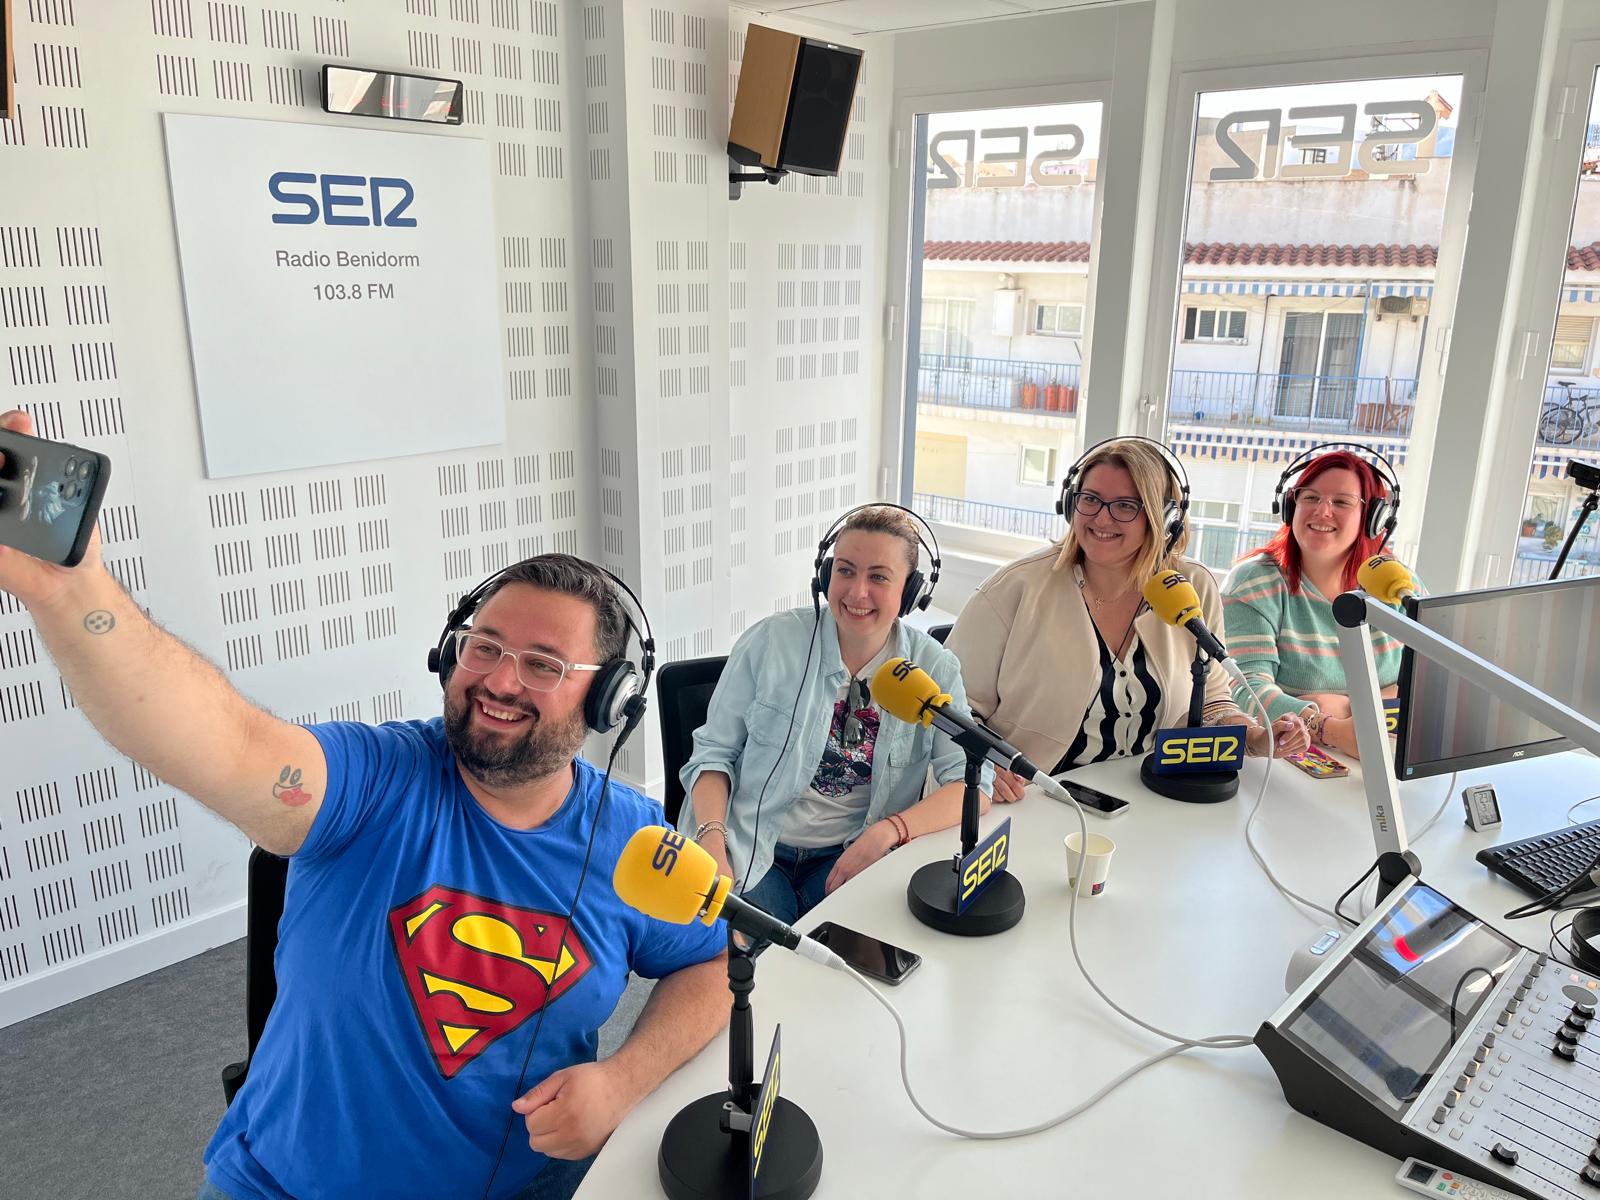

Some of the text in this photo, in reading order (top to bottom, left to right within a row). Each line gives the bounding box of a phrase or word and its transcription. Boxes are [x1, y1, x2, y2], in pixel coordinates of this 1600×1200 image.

[268, 171, 418, 228] SER
[275, 250, 420, 267] Radio Benidorm
[313, 283, 394, 300] 103.8 FM
[1162, 573, 1188, 590] SE
[892, 658, 920, 682] SE
[1160, 736, 1239, 765] SER
[652, 830, 687, 878] SE
[961, 834, 1007, 902] SER
